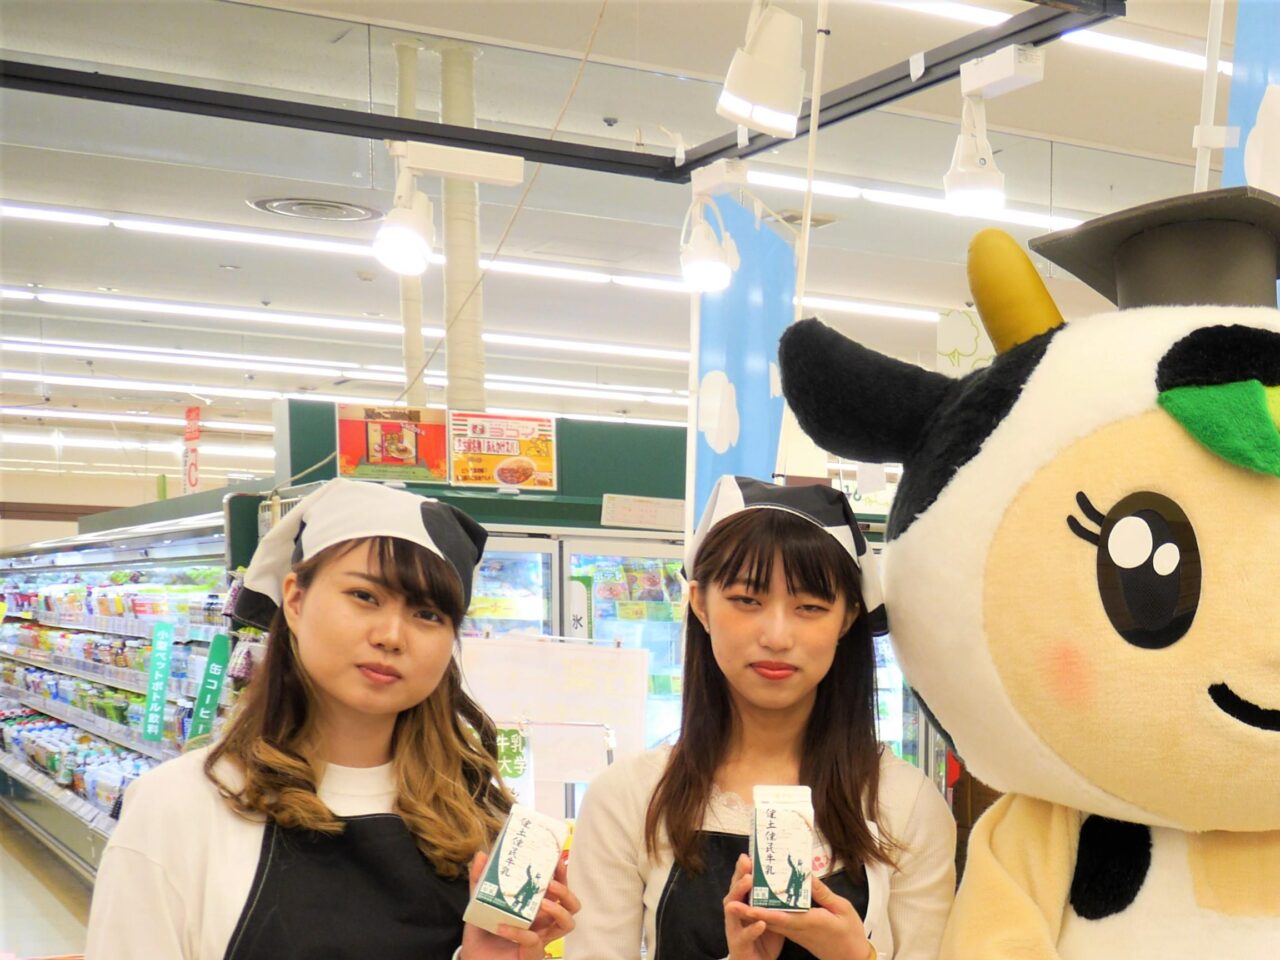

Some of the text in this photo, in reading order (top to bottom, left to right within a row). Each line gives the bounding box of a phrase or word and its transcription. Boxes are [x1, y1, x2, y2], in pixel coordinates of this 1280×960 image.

[572, 614, 584, 630] 氷
[197, 662, 224, 735] 缶コーヒー
[497, 757, 528, 775] 大学
